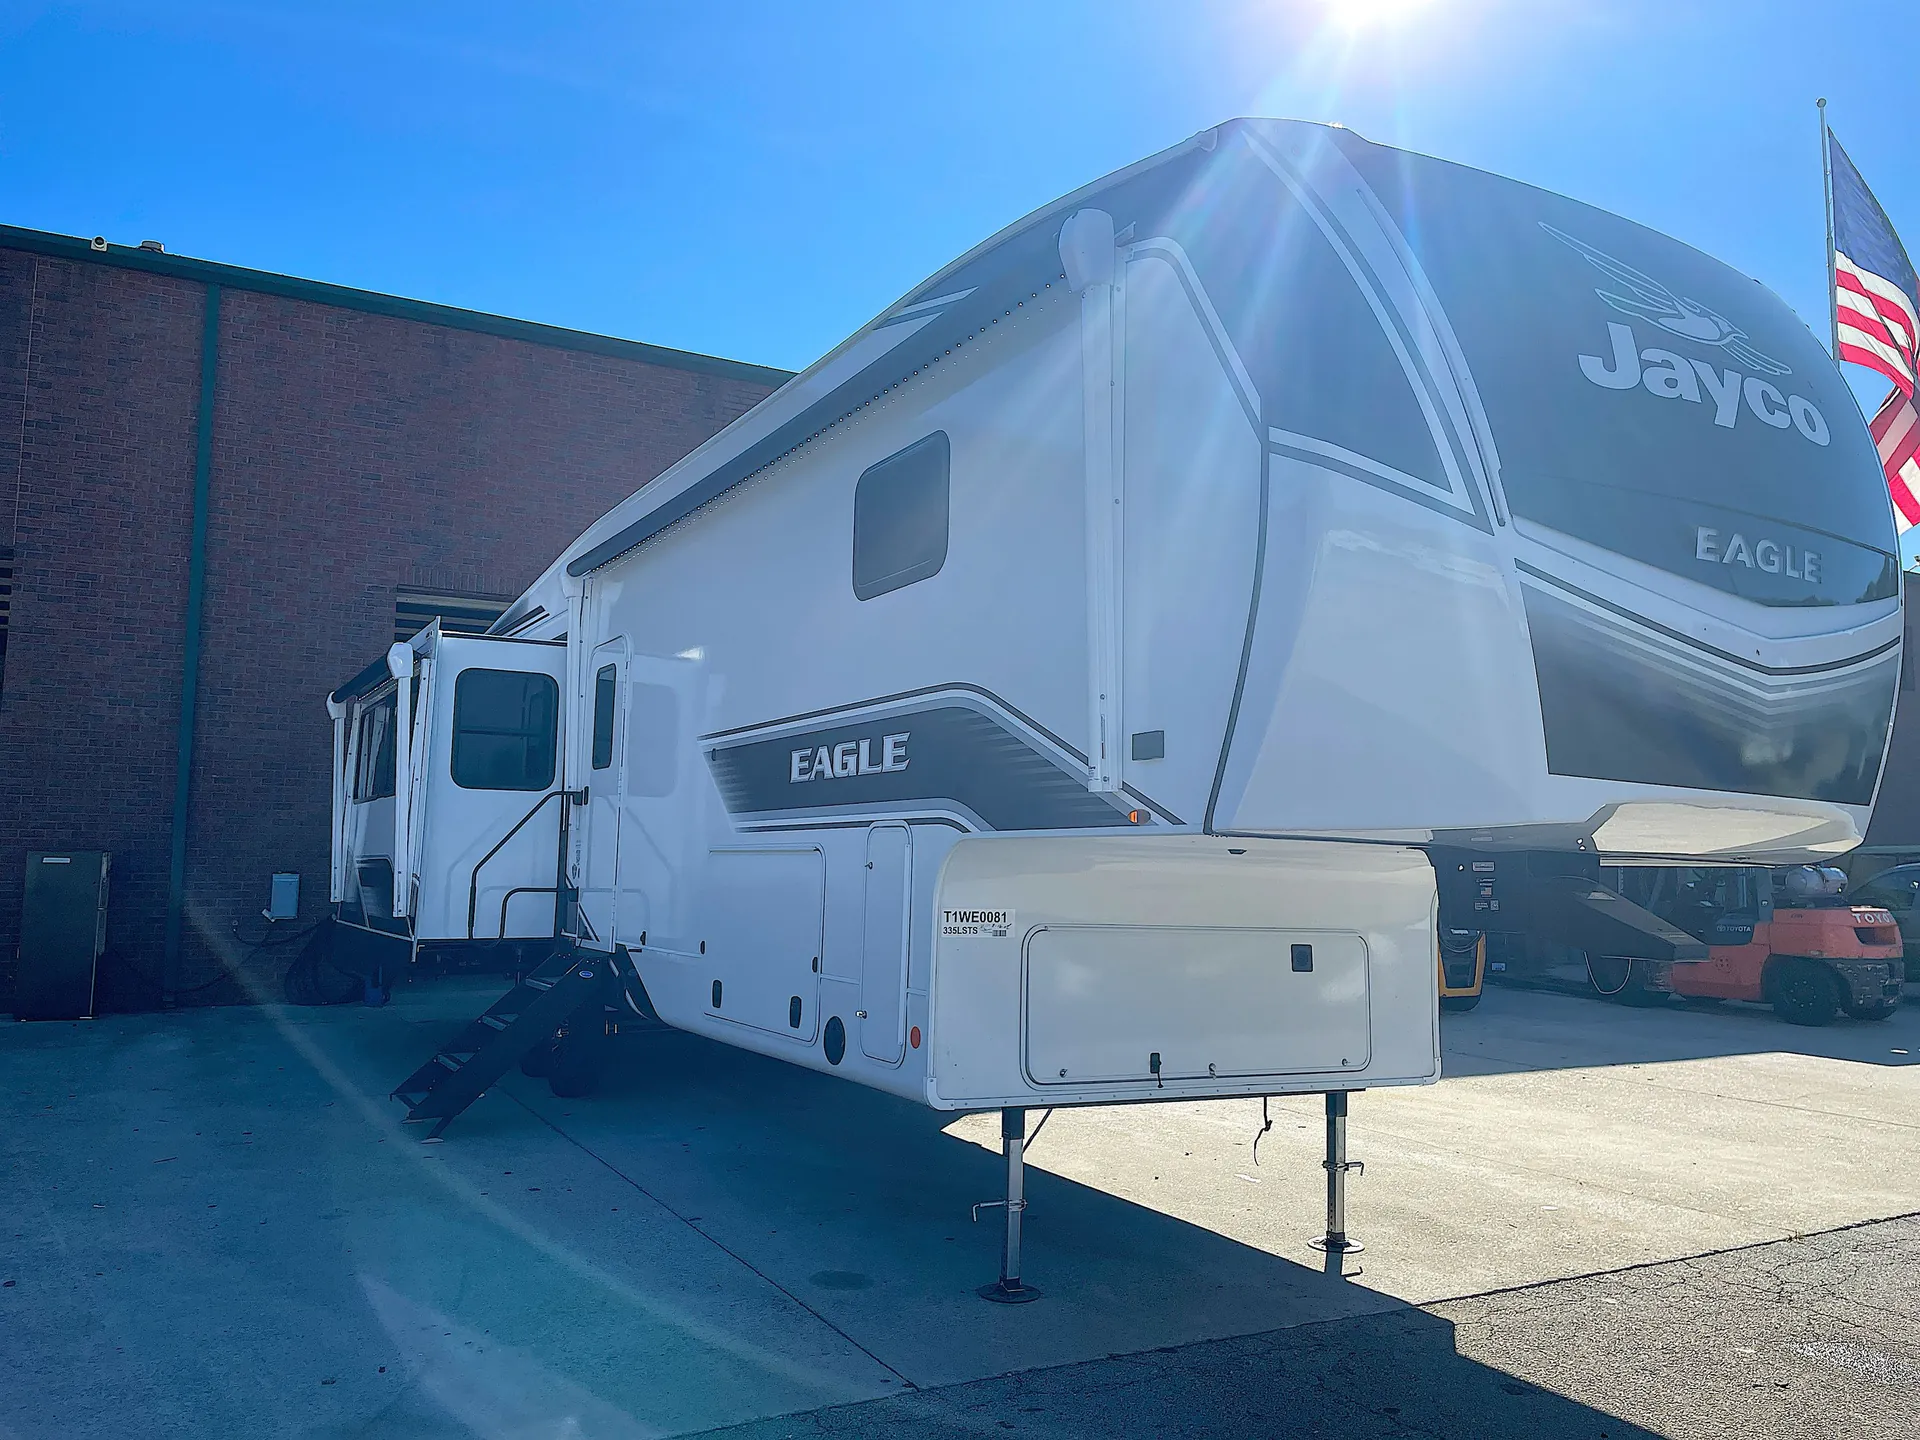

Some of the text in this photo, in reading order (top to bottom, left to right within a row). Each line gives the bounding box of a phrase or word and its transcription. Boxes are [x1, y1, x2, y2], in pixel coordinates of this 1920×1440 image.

[1578, 321, 1831, 446] Jayco
[1695, 526, 1822, 584] EAGLE
[790, 732, 910, 783] EAGLE
[943, 926, 978, 935] 335LSTS
[944, 911, 1007, 923] T1WE0081
